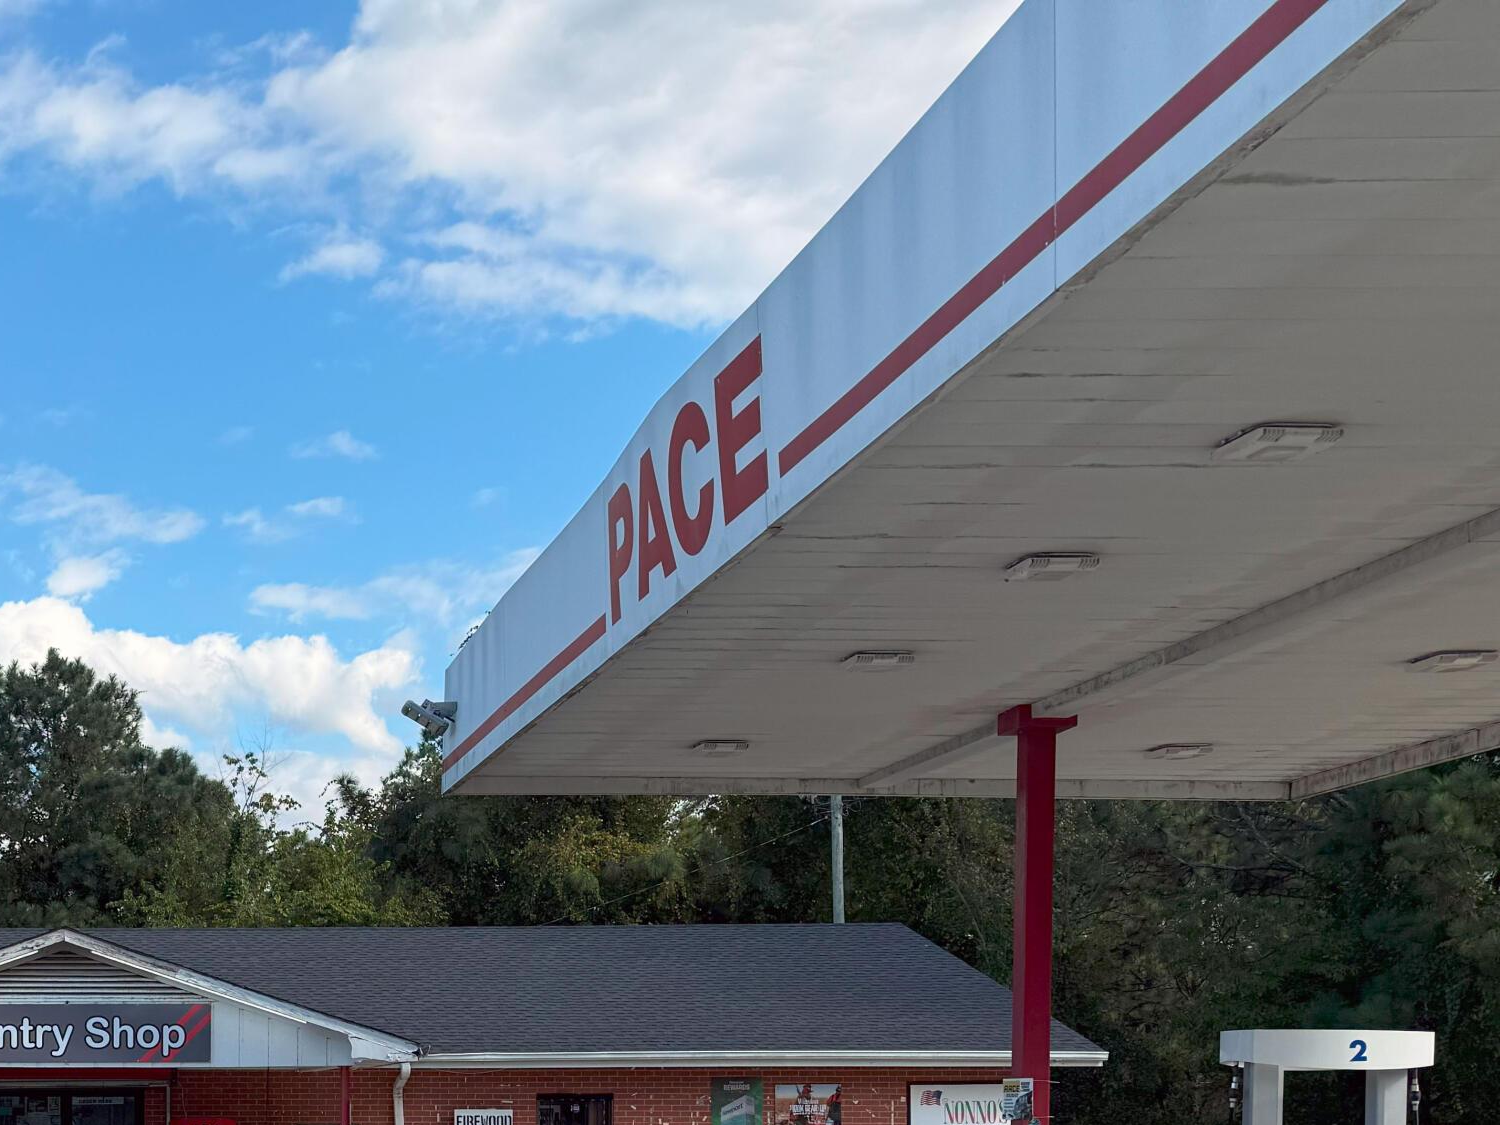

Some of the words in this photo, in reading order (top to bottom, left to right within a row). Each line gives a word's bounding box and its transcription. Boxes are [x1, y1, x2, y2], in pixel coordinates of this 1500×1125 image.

[608, 333, 769, 626] PACE
[84, 1016, 186, 1057] Shop
[1349, 1040, 1367, 1062] 2
